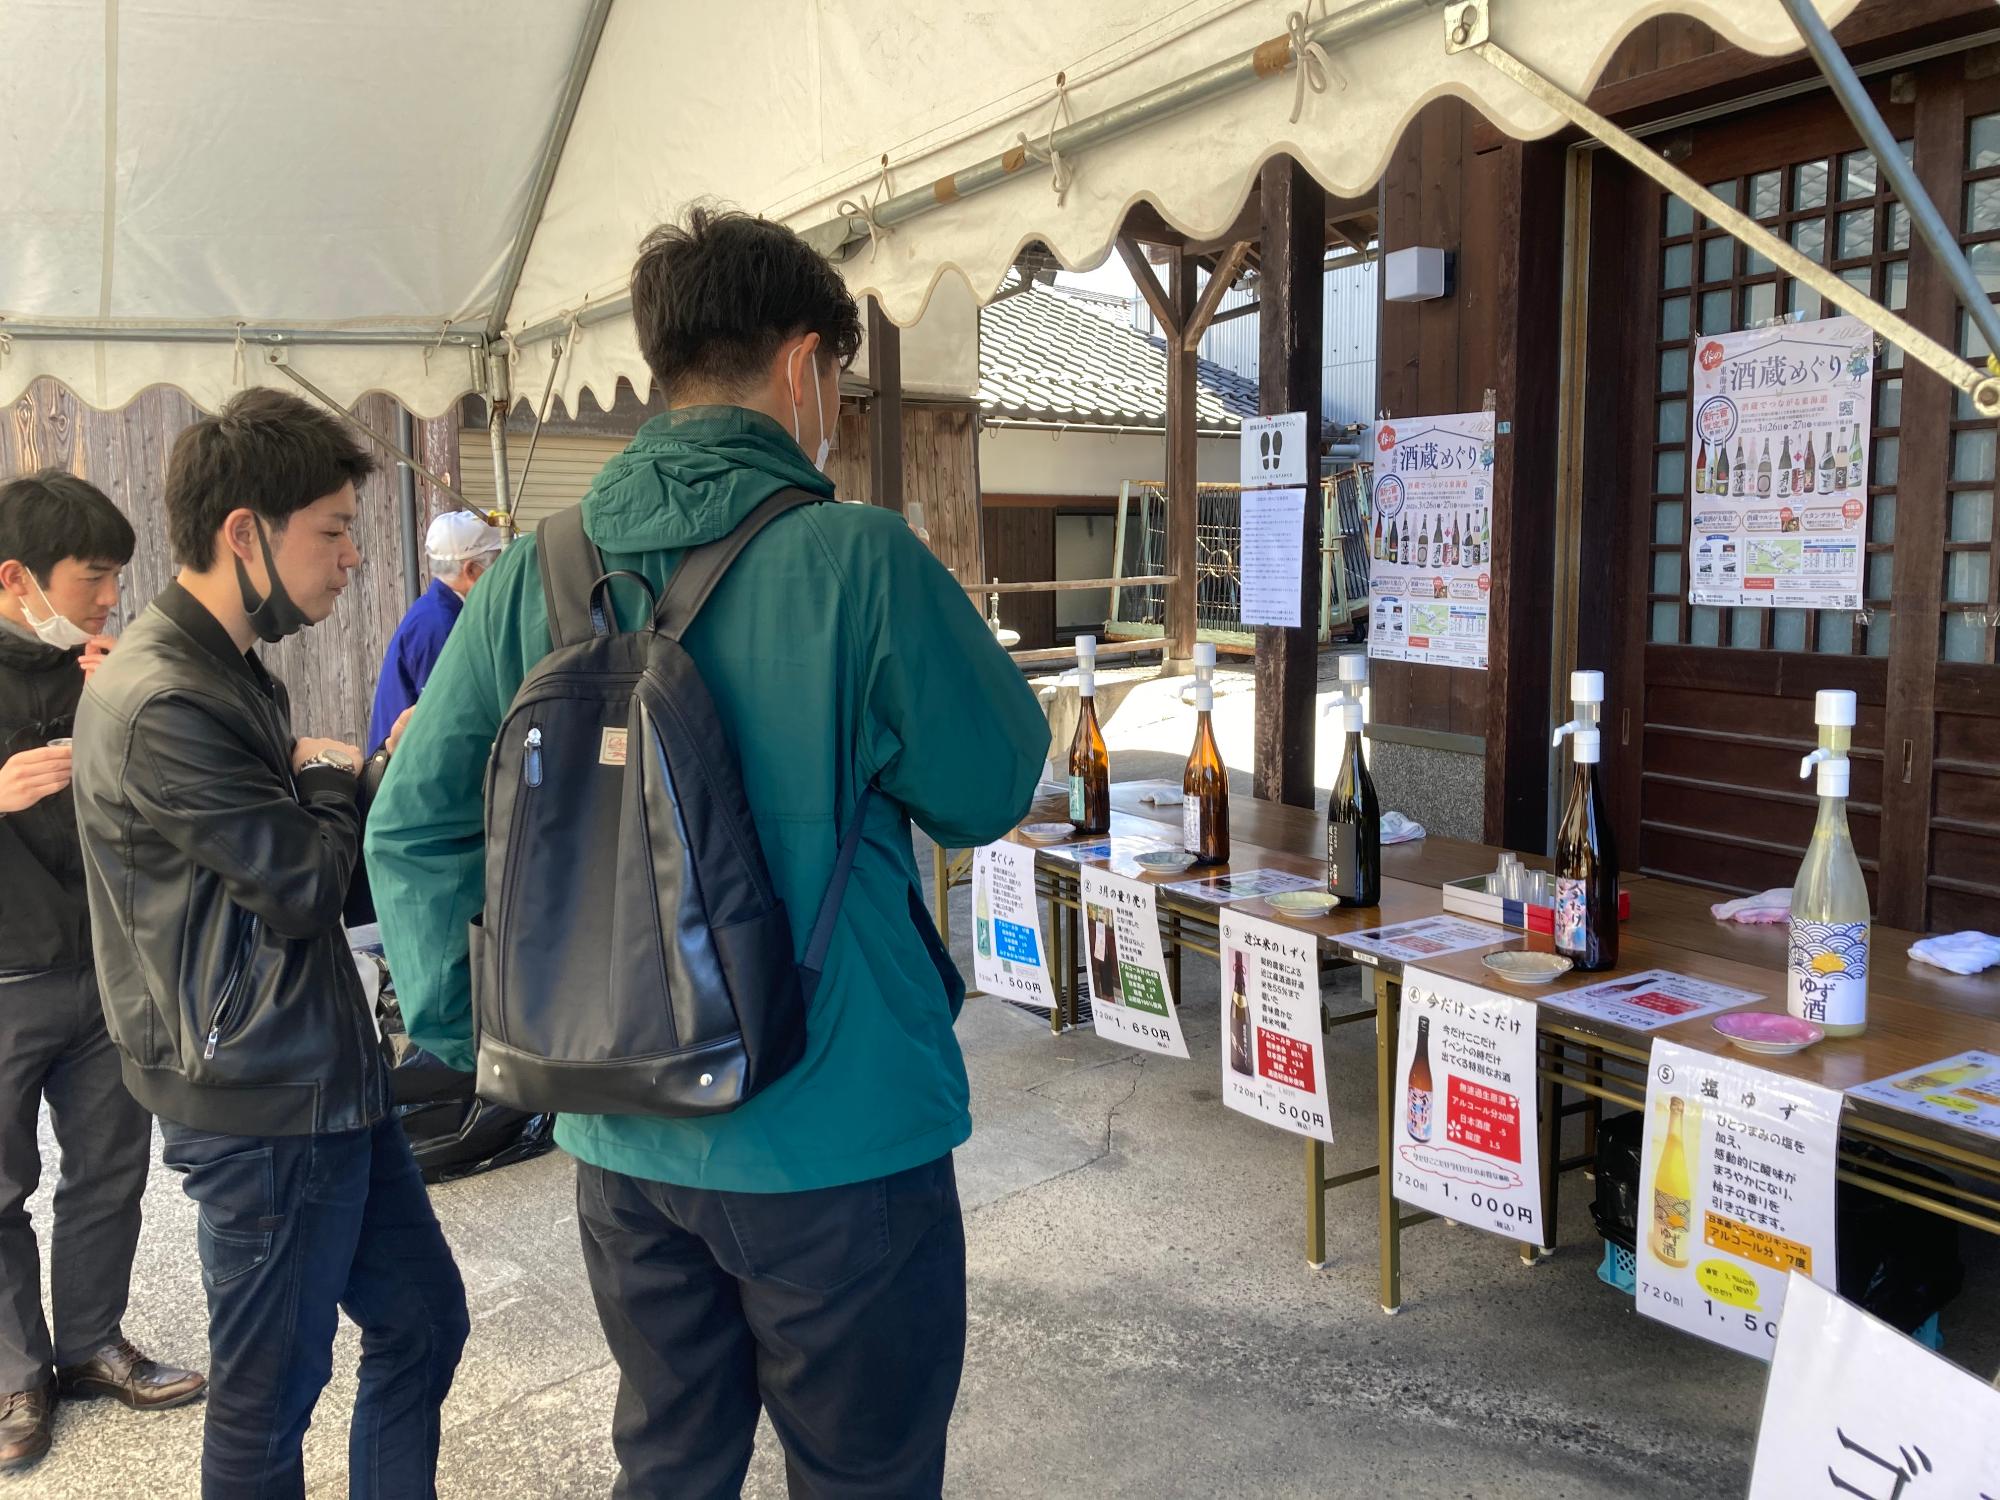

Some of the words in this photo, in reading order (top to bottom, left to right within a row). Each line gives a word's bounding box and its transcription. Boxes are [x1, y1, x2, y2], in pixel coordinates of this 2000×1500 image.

[1730, 355, 1842, 392] 酒蔵めぐり
[1400, 442, 1477, 472] 酒蔵めぐり
[1099, 885, 1147, 909] 3月の量り売り
[1244, 931, 1306, 962] 近江米のしずく
[1427, 992, 1521, 1035] 今だけここだけ
[1442, 1025, 1497, 1050] 今だけここだけ
[1442, 1039, 1502, 1066] イベントの時だけ
[1441, 1052, 1511, 1083] 出てくる特別なお酒
[1460, 1113, 1492, 1132] 日本酒度
[1716, 1113, 1806, 1155] ひとつまみの塩を
[1715, 1131, 1742, 1150] 加え、
[1397, 1172, 1428, 1191] 720ml
[1714, 1148, 1797, 1185] 感動的に酸味が
[1713, 1164, 1793, 1201] まろやかになり、
[1713, 1180, 1781, 1213] 柚子の香りを
[1712, 1196, 1786, 1232] 引き立てます。
[1709, 1215, 1807, 1255] 日本酒ベースのリキュール
[1710, 1226, 1774, 1258] アルコール分
[1786, 1254, 1806, 1270] 7度
[1641, 1281, 1684, 1308] 720ml
